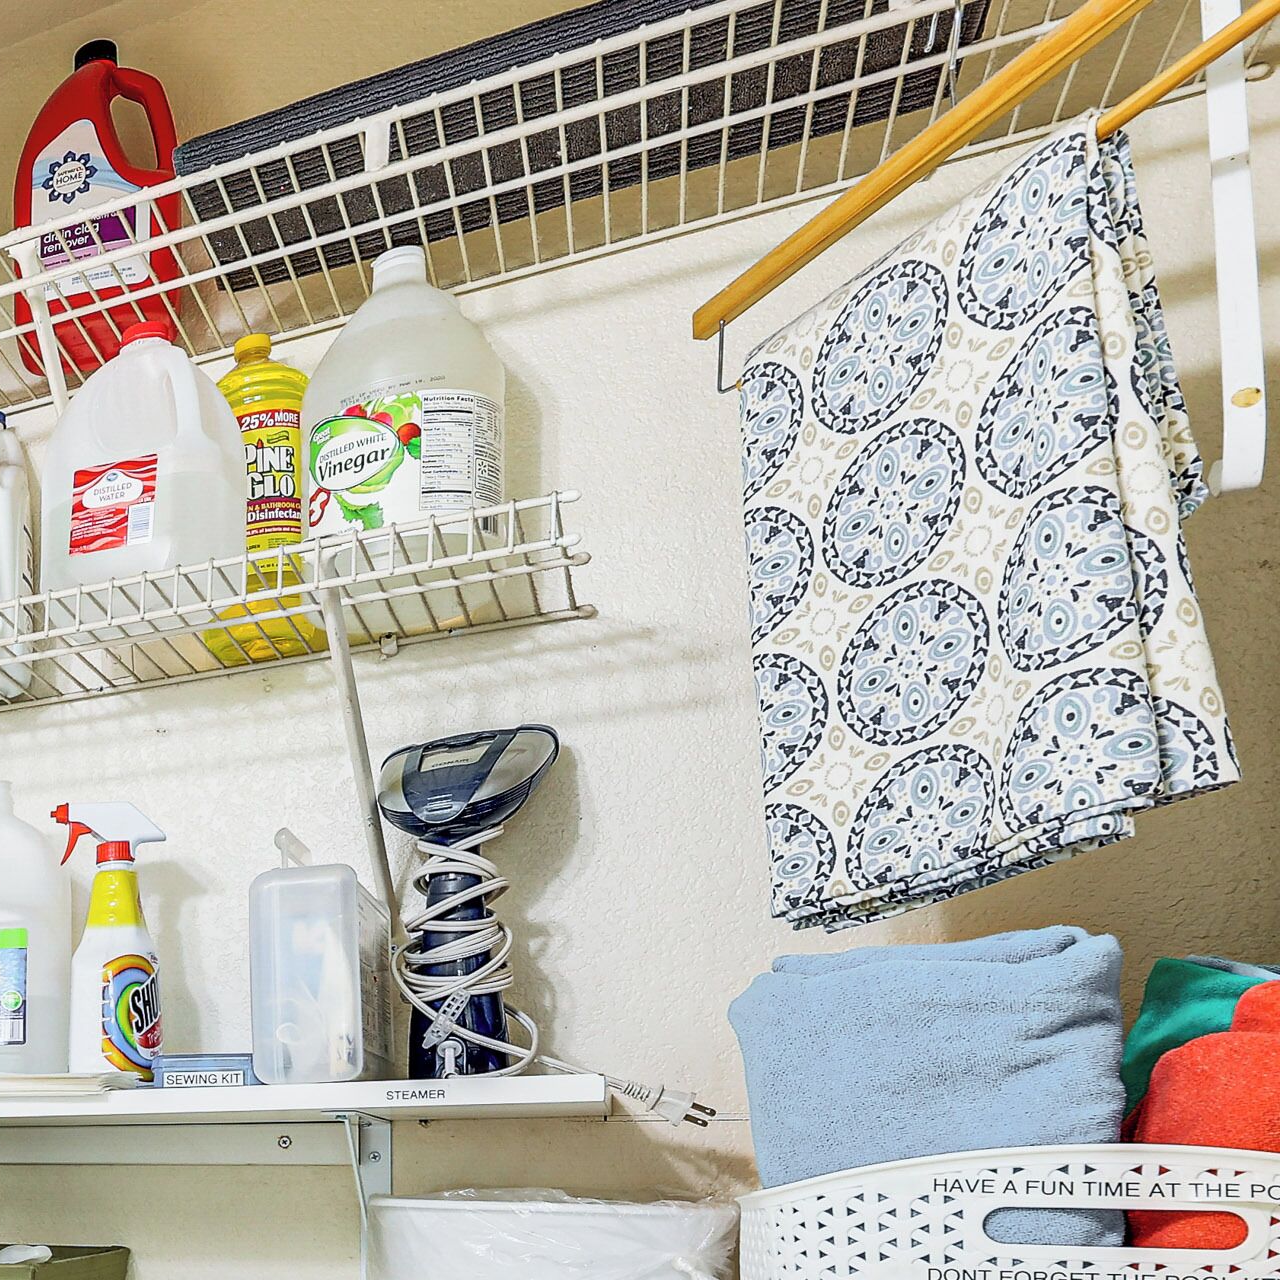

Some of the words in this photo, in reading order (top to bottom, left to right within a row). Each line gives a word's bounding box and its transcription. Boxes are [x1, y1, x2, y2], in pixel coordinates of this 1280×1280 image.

[55, 171, 83, 185] HOME
[456, 395, 474, 403] Facts
[241, 413, 275, 432] 25%
[274, 411, 299, 424] MORE
[320, 441, 355, 463] DISTILLED
[356, 432, 387, 447] WHITE
[244, 439, 294, 474] PINE
[318, 447, 390, 481] Vinegar
[93, 482, 133, 496] DISTILLED
[246, 471, 295, 500] GLO
[99, 491, 125, 502] WATER
[247, 508, 301, 522] Disinfectan
[166, 1073, 218, 1086] SEWING
[221, 1073, 241, 1085] KIT
[386, 1089, 446, 1101] STEAMER
[933, 1178, 995, 1194] HAVE
[1003, 1180, 1018, 1195] A
[1025, 1180, 1074, 1196] FUN
[1082, 1181, 1140, 1197] TIME
[1148, 1182, 1181, 1198] AT
[1190, 1183, 1240, 1198] THE
